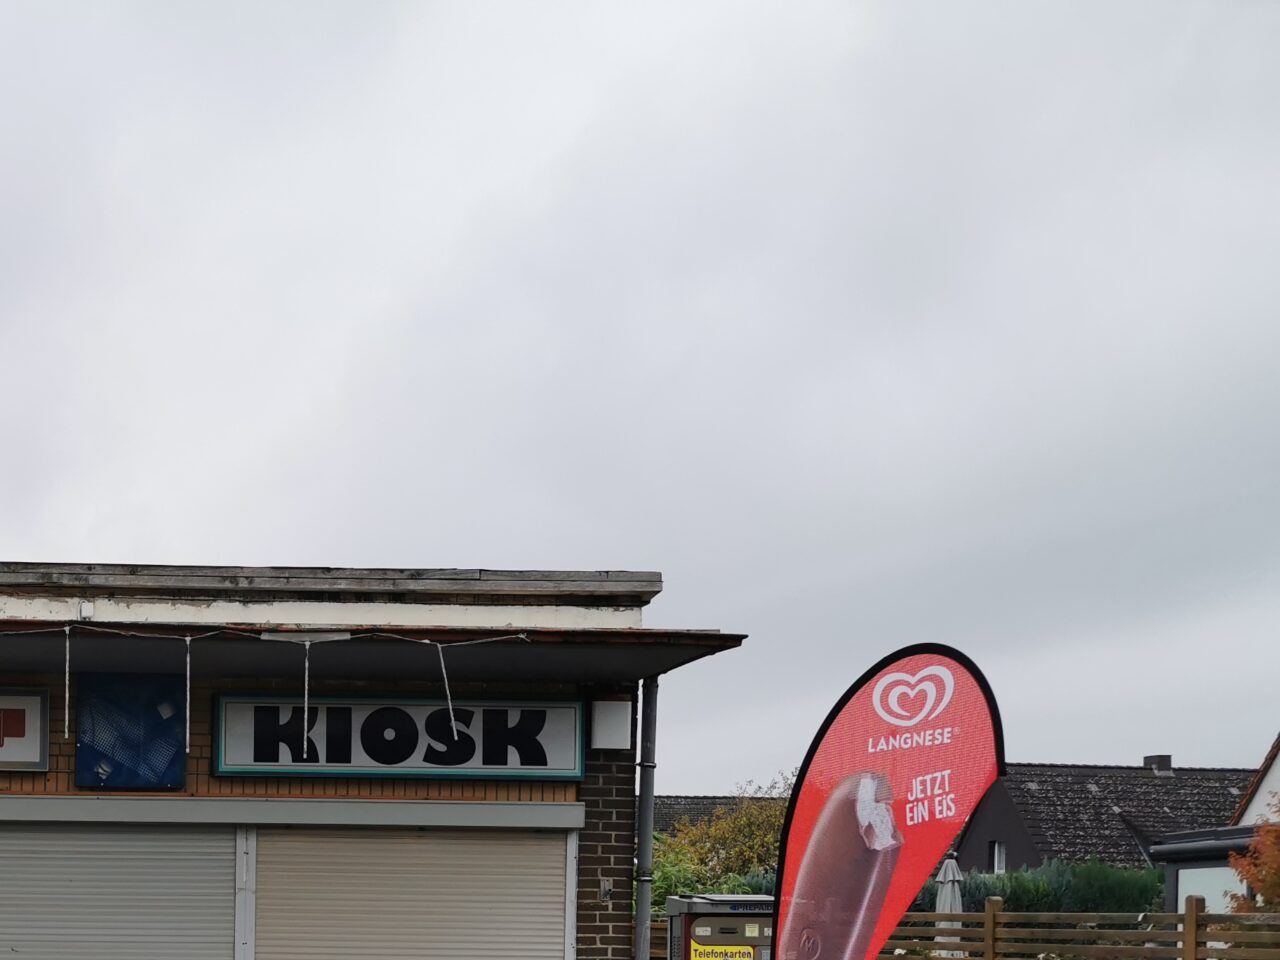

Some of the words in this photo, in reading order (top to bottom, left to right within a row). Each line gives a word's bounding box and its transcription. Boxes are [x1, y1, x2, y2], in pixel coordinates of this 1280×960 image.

[253, 706, 548, 767] KIOSK
[868, 726, 952, 753] LANGNESE
[907, 769, 952, 801] JETZT
[693, 948, 752, 959] Telefonkarten
